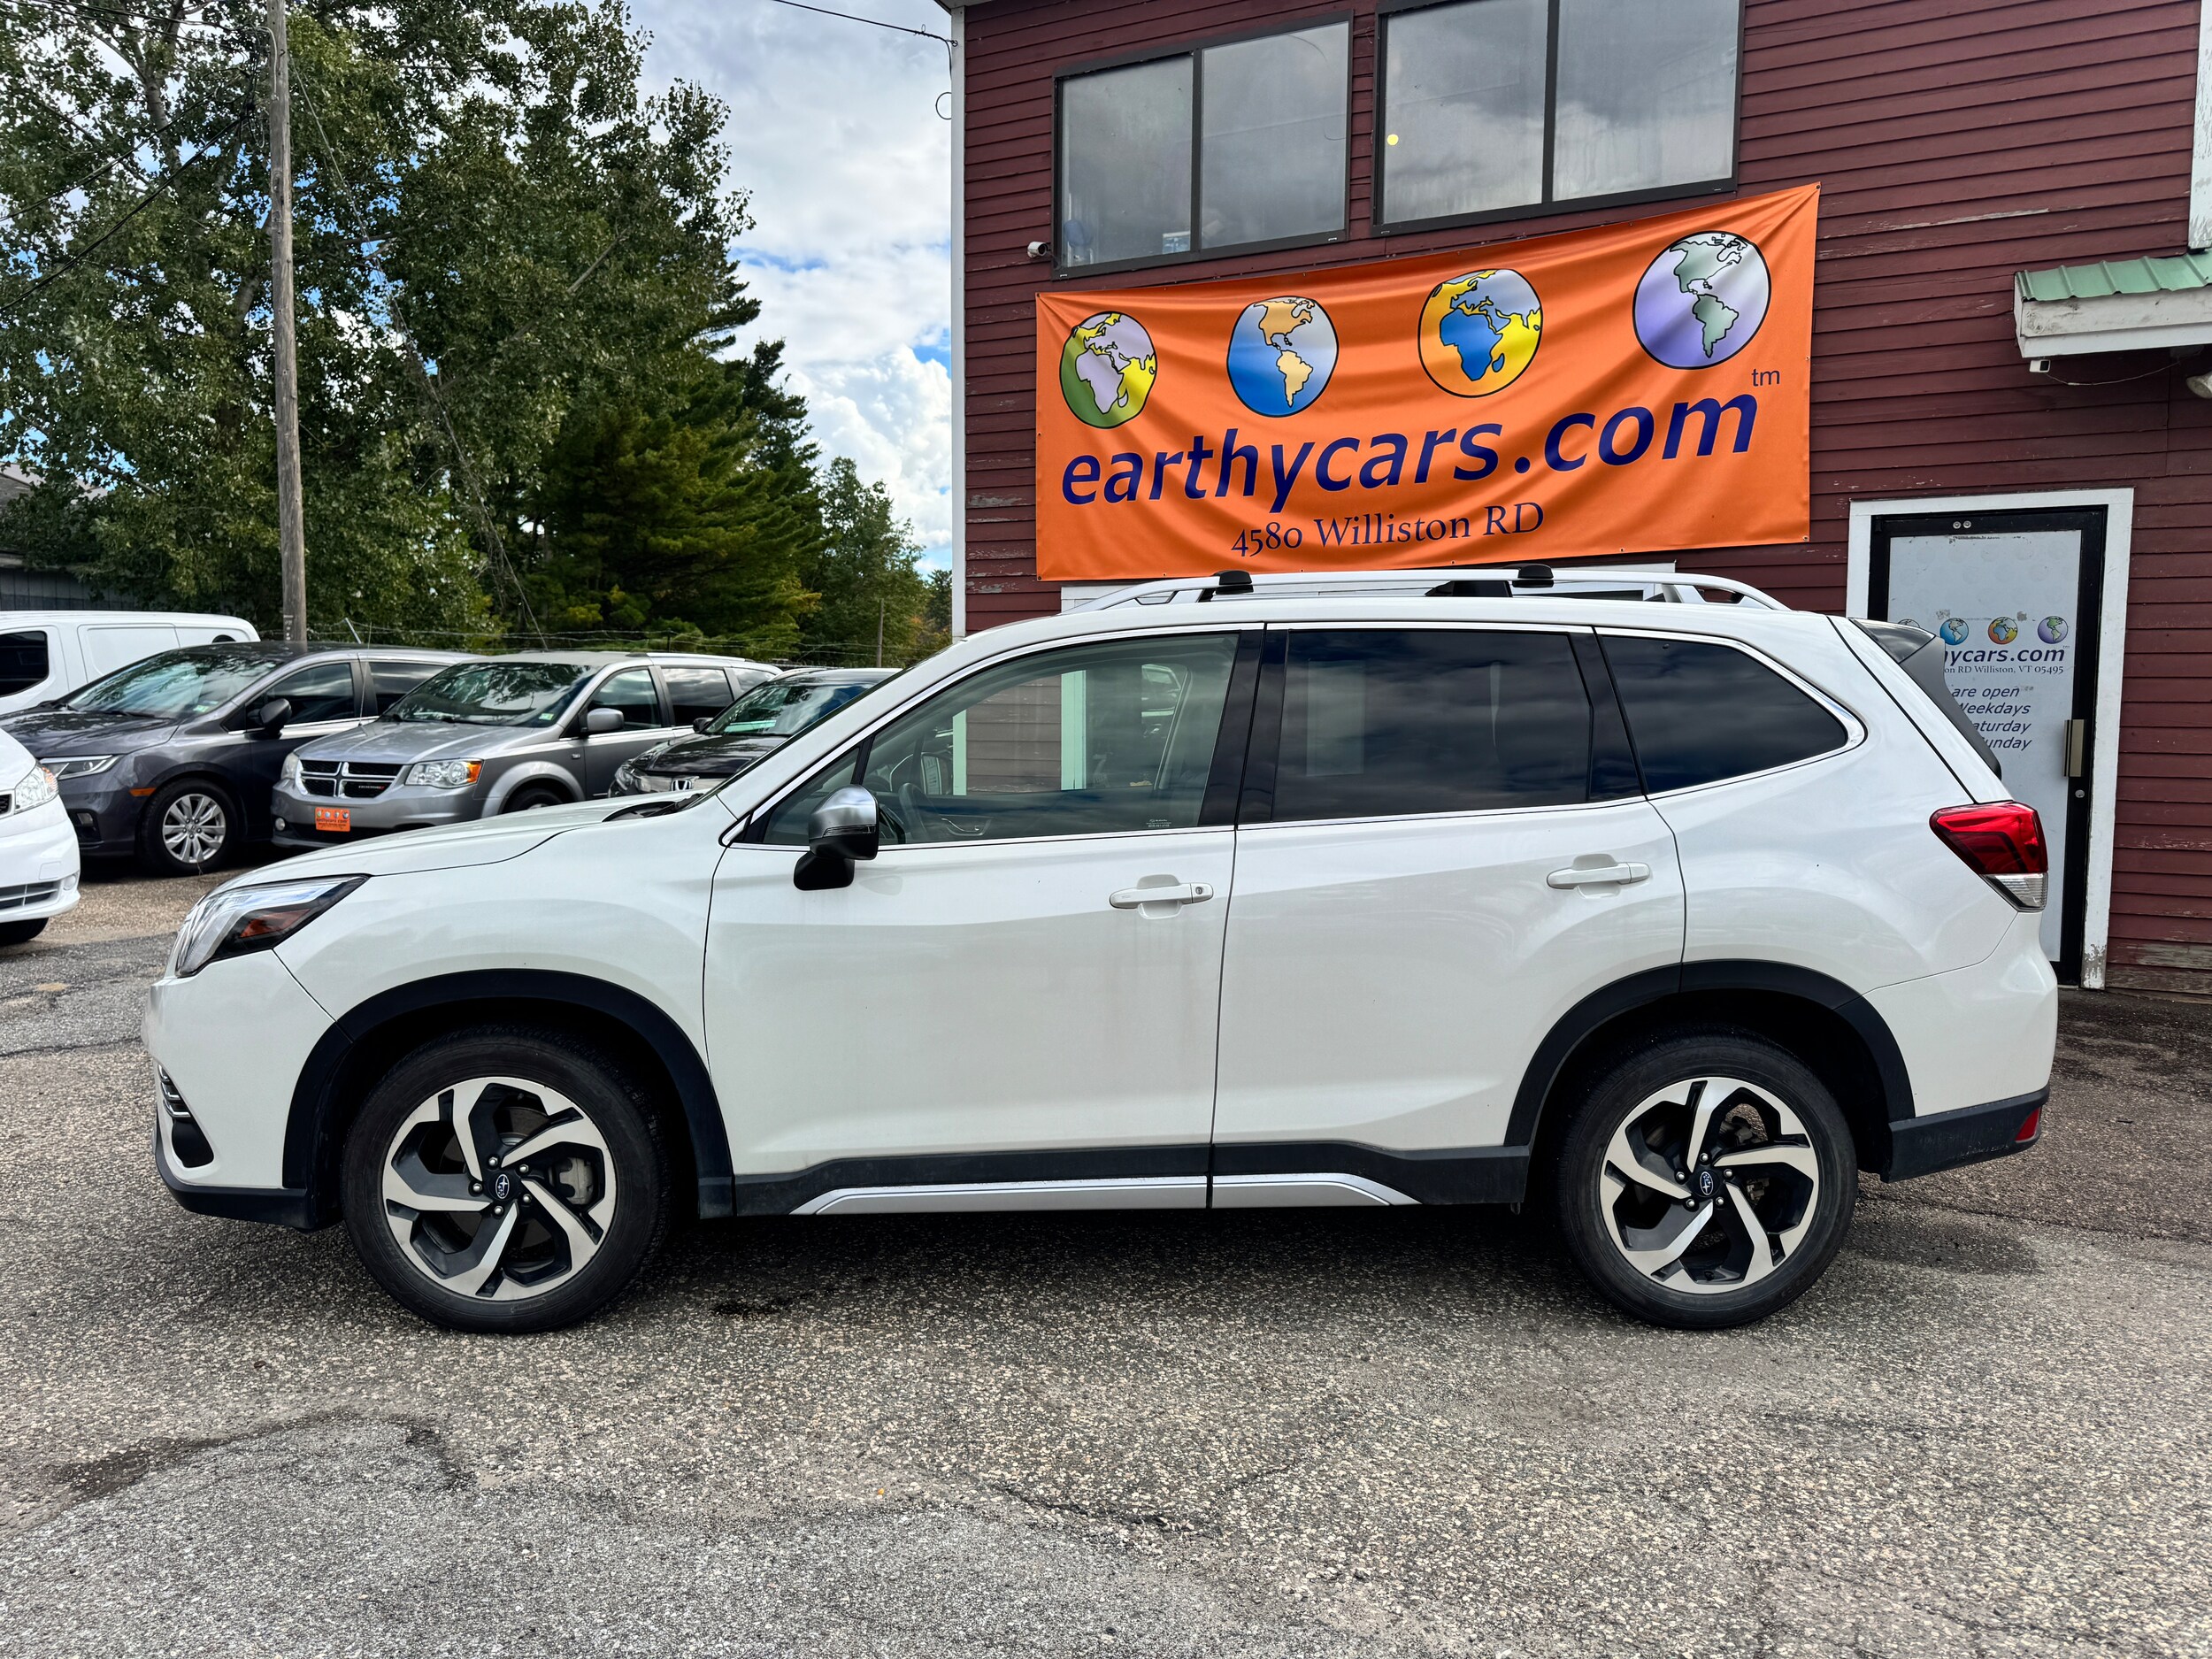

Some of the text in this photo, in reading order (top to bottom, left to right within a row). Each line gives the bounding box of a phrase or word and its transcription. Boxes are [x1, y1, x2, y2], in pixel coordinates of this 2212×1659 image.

[1751, 368, 1780, 387] tm
[1062, 393, 1758, 513] earthycars.com
[1231, 502, 1544, 557] 4580 Williston RD
[1974, 665, 2016, 674] Williston,
[2034, 666, 2063, 675] 05495
[1952, 687, 2020, 700] are open
[1973, 719, 2032, 734] aturday
[1982, 736, 2032, 751] unday
